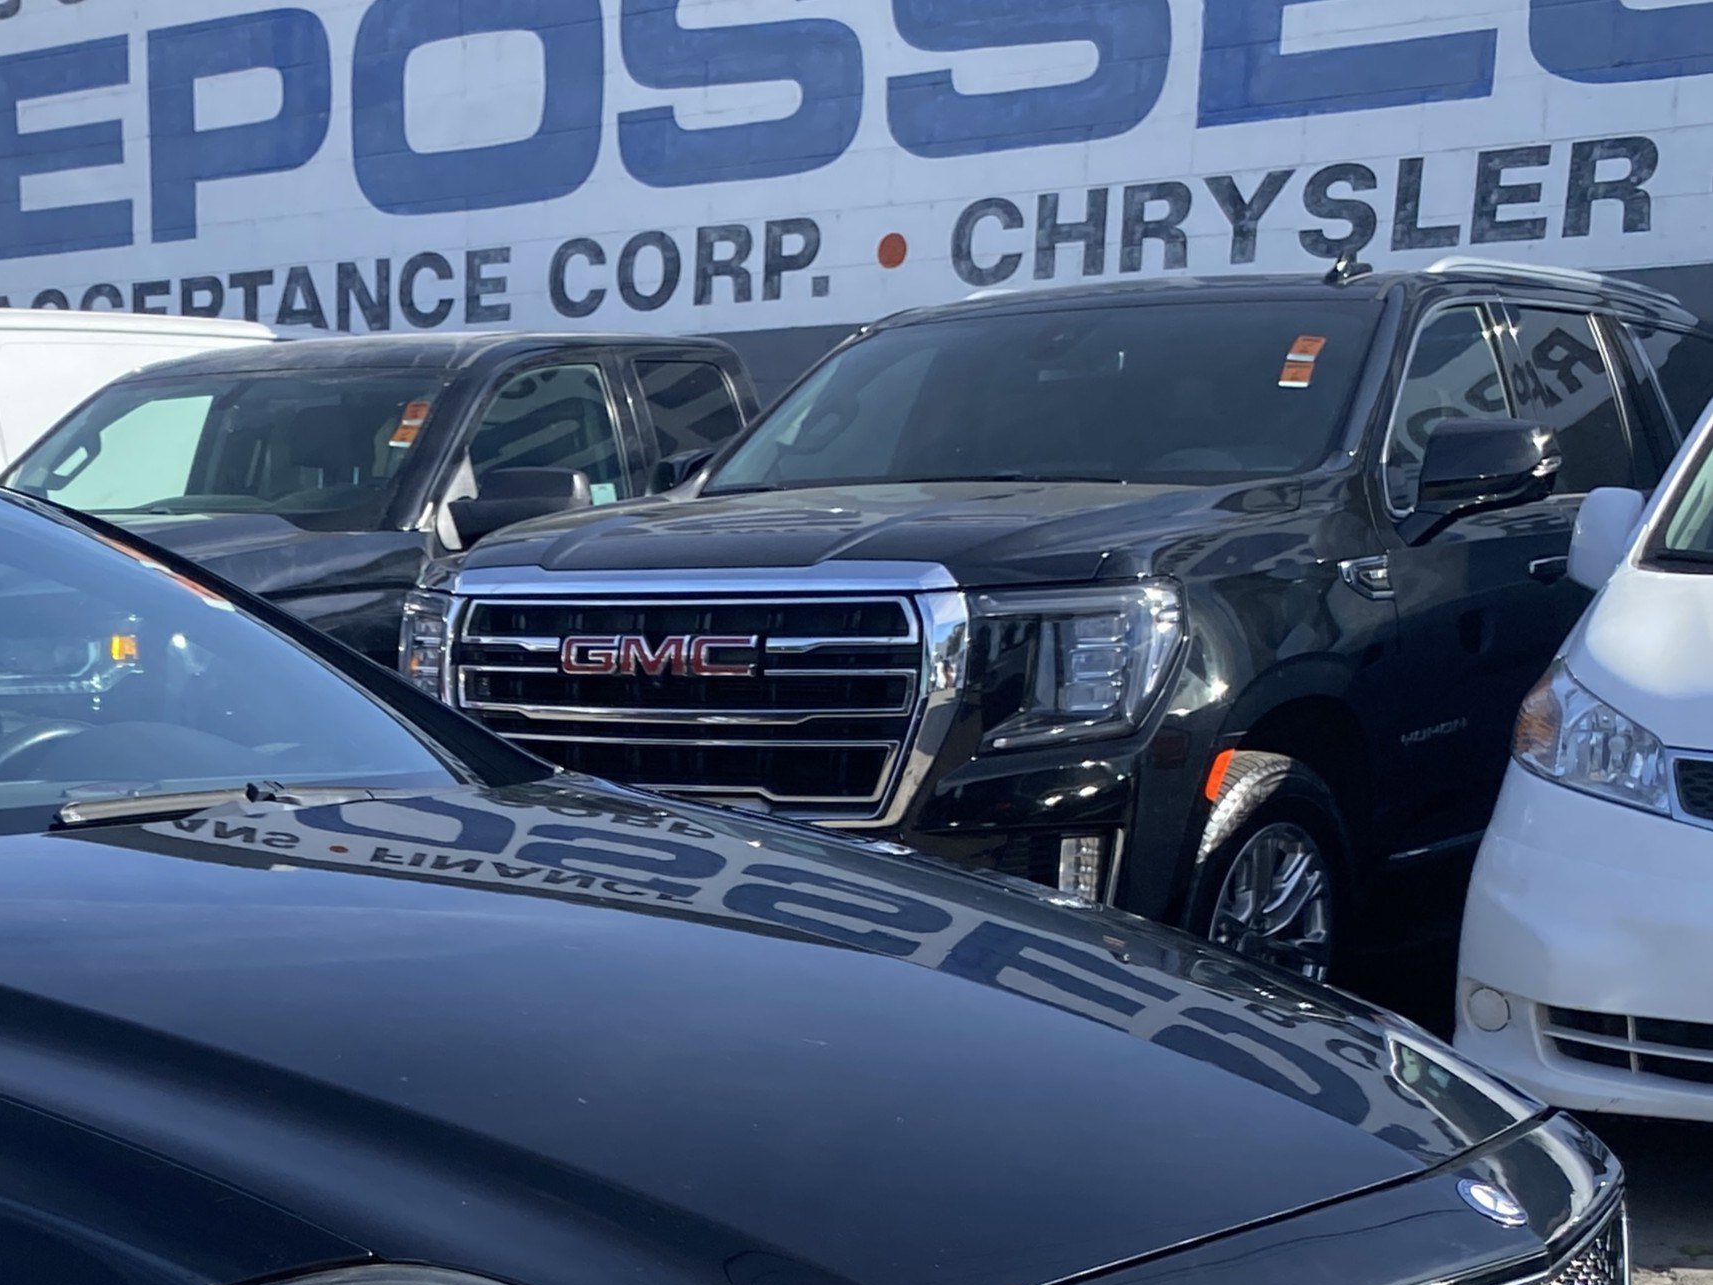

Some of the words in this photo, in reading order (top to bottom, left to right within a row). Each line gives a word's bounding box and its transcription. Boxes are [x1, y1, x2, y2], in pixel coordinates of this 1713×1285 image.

[548, 217, 831, 318] CORP.
[951, 136, 1660, 288] CHRYSLER
[560, 633, 760, 679] GMC
